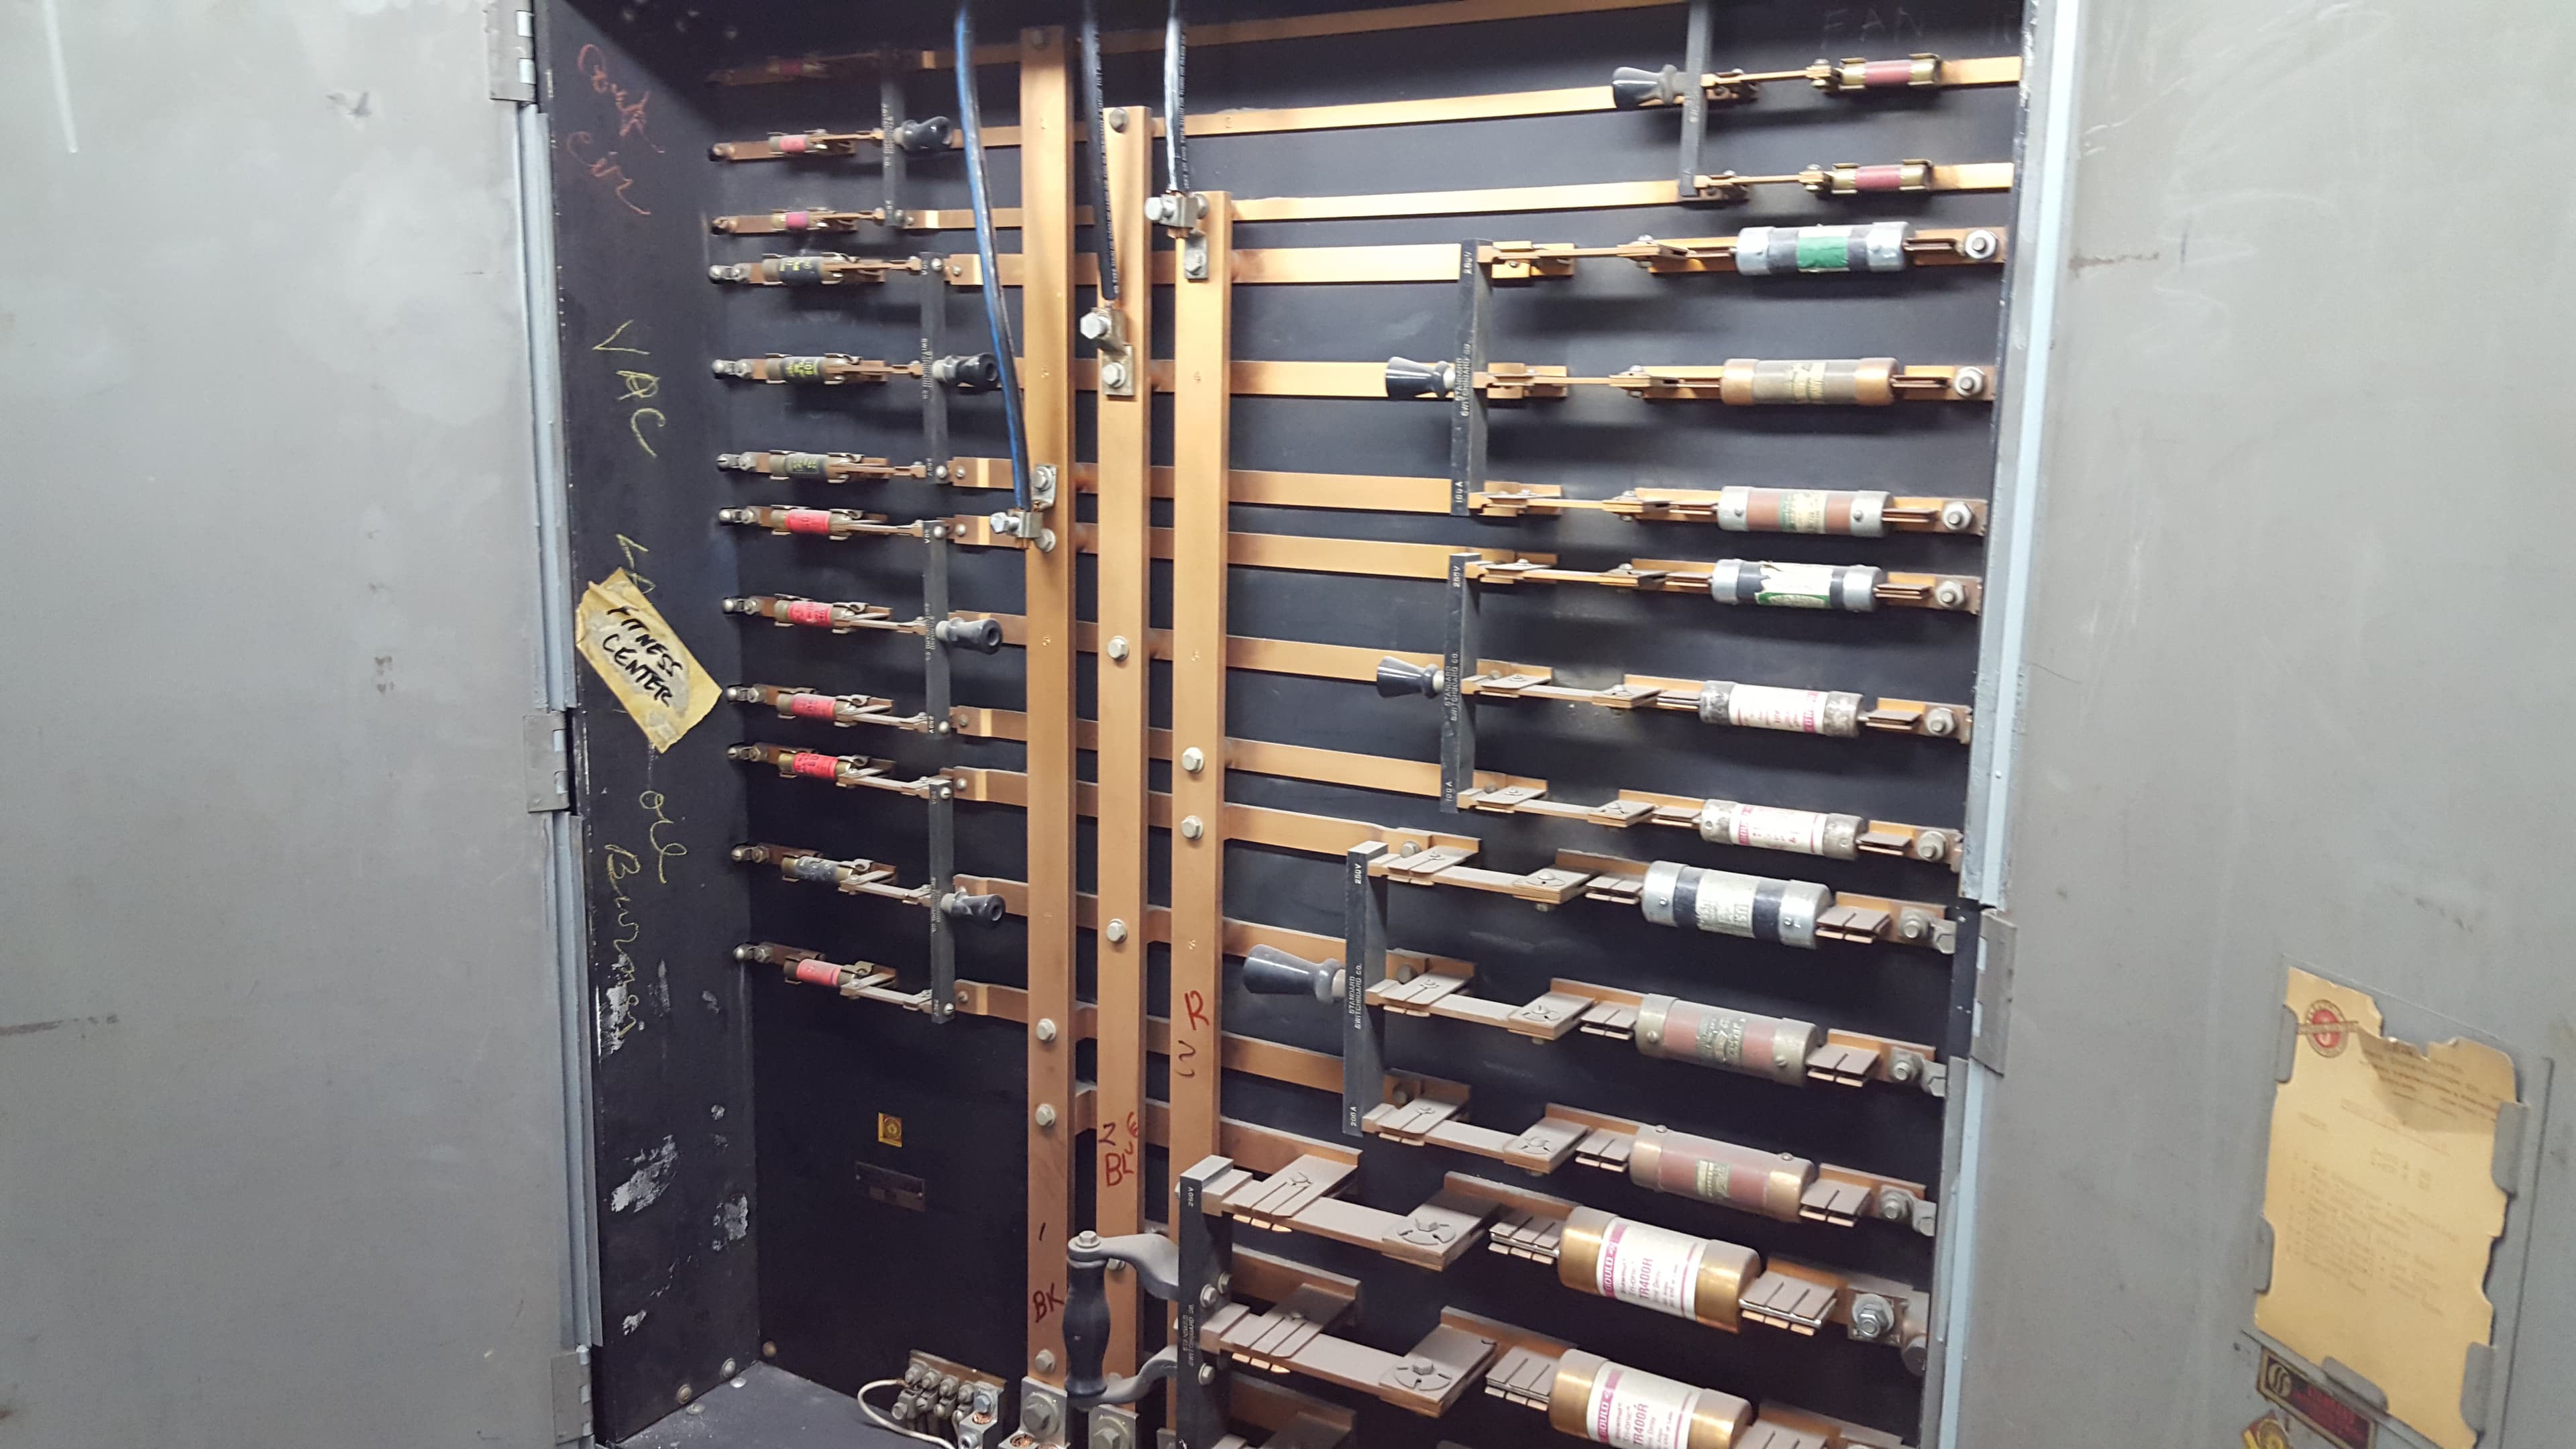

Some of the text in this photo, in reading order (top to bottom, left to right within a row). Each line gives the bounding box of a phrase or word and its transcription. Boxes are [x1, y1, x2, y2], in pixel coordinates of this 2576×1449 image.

[592, 319, 666, 459] VAC
[606, 605, 683, 677] FITNESS
[603, 633, 673, 708] CENTER
[1184, 989, 1210, 1030] R
[1098, 1121, 1116, 1146] 2
[1033, 1283, 1065, 1324] BK
[1633, 1403, 1649, 1446] TR400R
